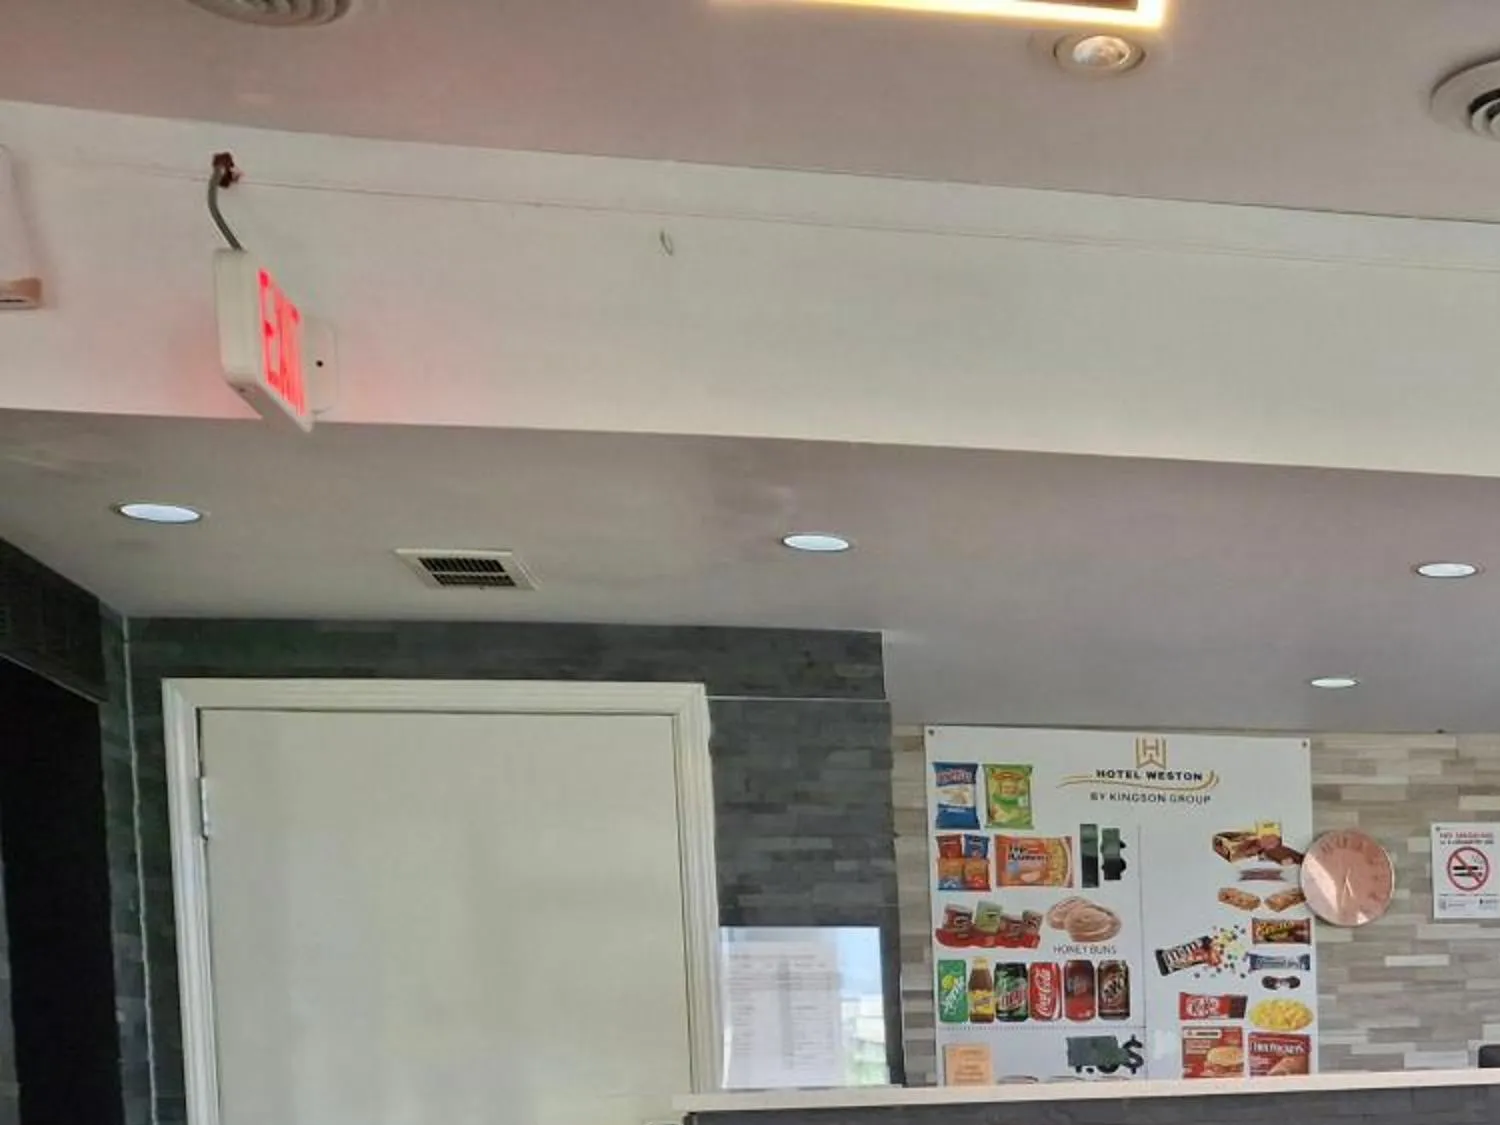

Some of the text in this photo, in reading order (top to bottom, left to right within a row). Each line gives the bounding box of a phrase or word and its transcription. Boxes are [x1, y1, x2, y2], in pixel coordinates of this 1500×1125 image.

[1096, 769, 1203, 781] HOTEL WESTON
[1090, 792, 1211, 805] BY KINGSON GROUP
[1053, 945, 1117, 955] HONEY BUNS
